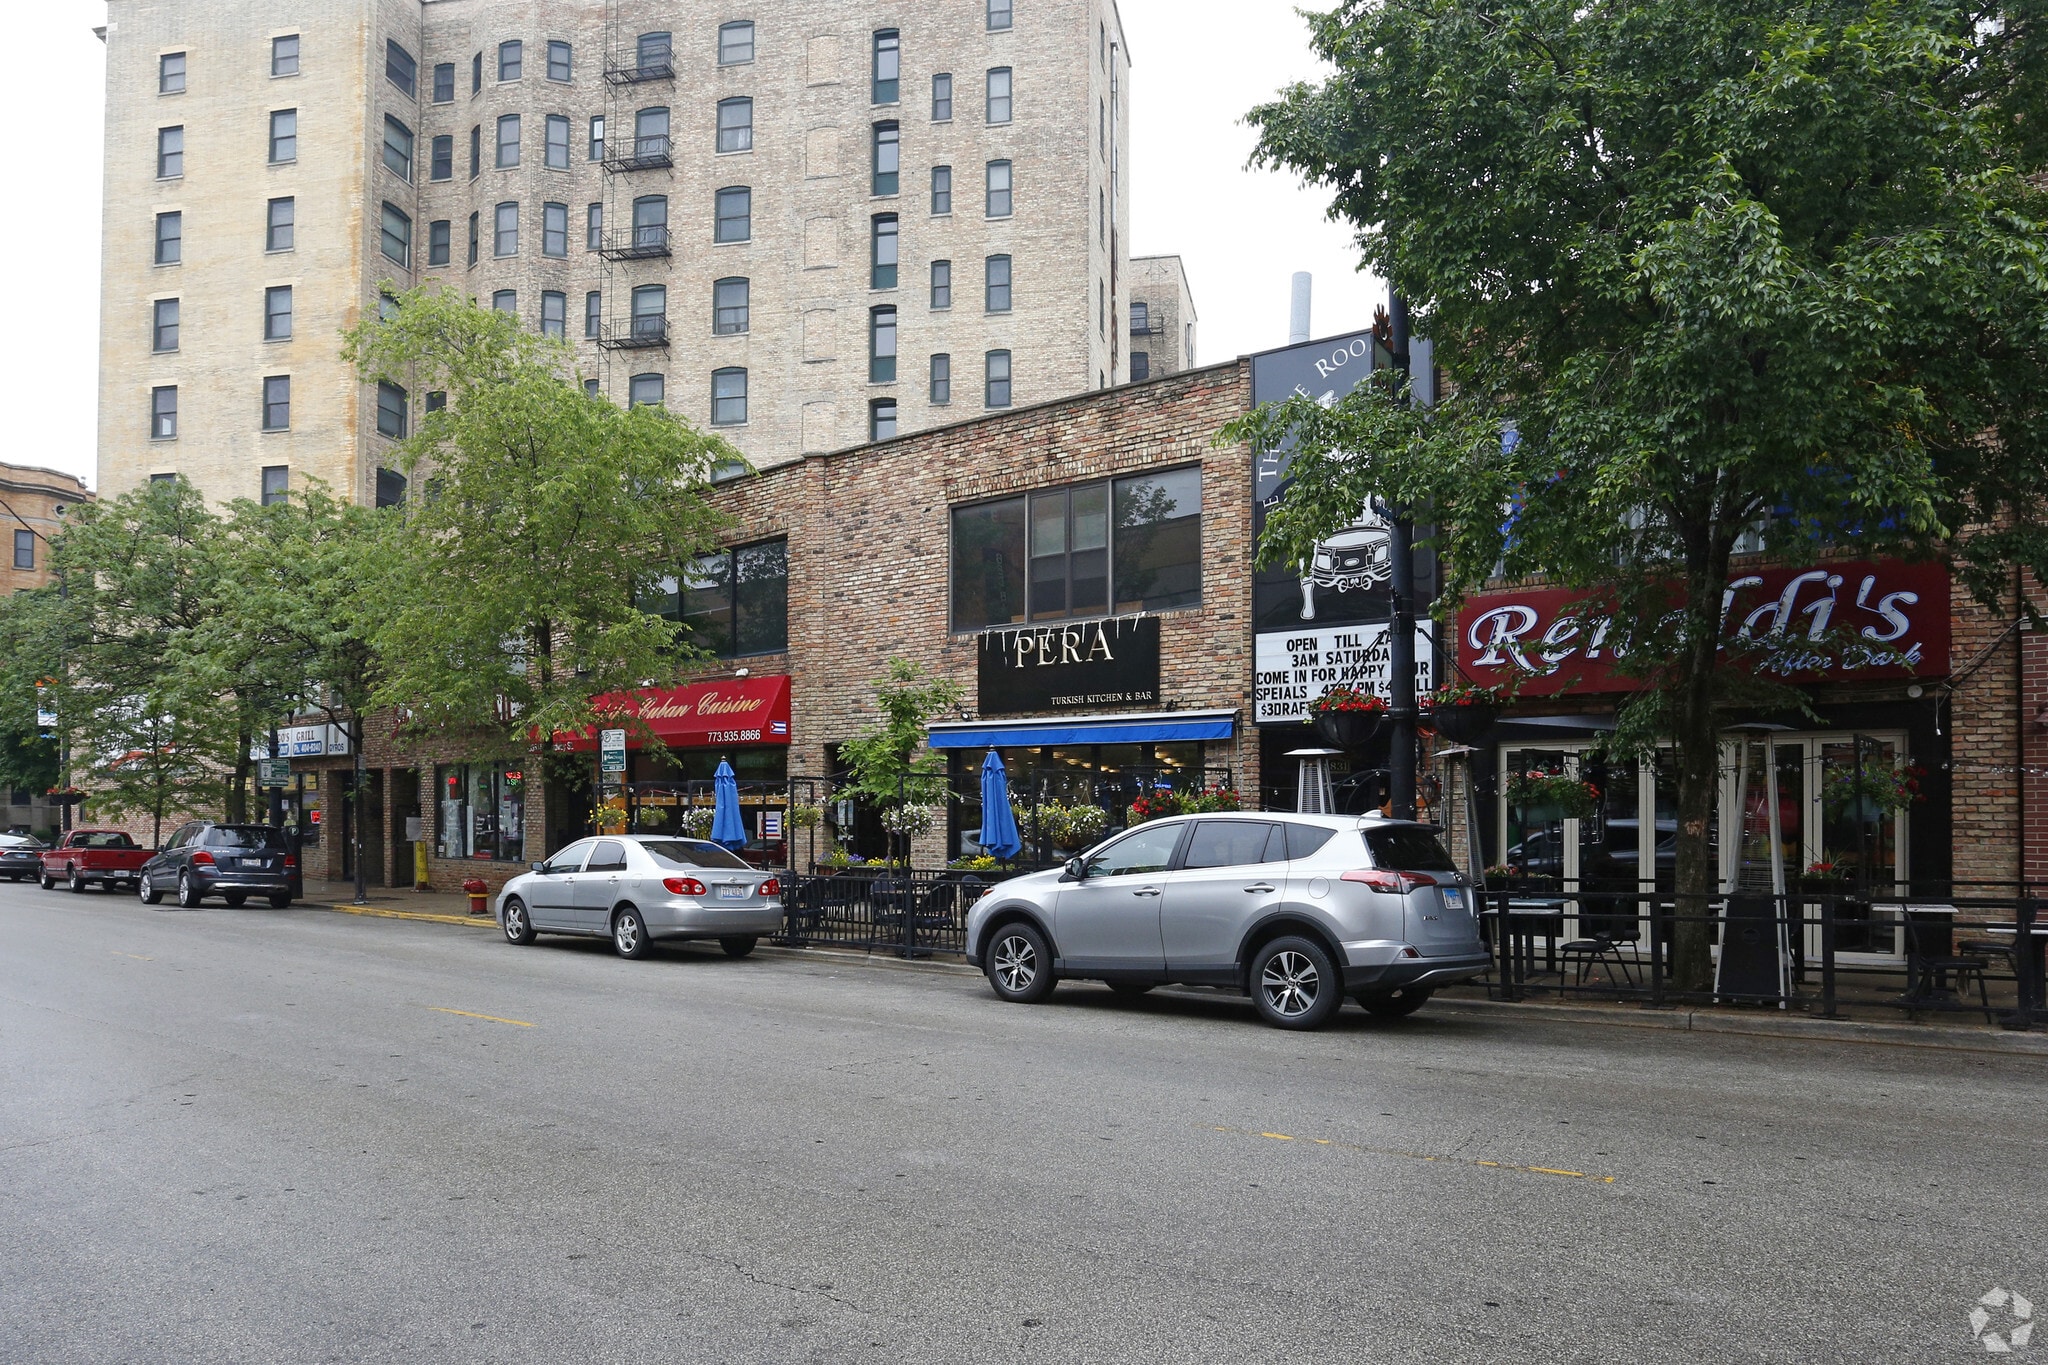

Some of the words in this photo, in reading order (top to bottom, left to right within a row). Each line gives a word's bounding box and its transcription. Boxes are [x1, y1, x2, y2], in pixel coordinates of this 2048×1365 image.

[1313, 338, 1372, 379] ROO
[1015, 628, 1114, 668] PERA
[1286, 637, 1317, 652] OPEN
[1333, 633, 1362, 648] TILL
[1377, 631, 1391, 645] 2A
[1291, 652, 1319, 668] 3AM
[1326, 648, 1390, 665] SATURDA
[1256, 670, 1290, 685] COME
[1294, 669, 1307, 683] IN
[1311, 668, 1337, 682] FOR
[1341, 664, 1385, 680] HAPPY
[1050, 694, 1085, 706] TURKISH
[1087, 692, 1123, 704] KITCHEN
[1125, 691, 1132, 701] &
[1134, 690, 1153, 701] BAR
[1256, 685, 1308, 700] SPEIALS
[1357, 681, 1375, 694] PM
[637, 697, 695, 720] Cuban
[697, 691, 766, 716] Cuisine
[296, 730, 315, 742] GRILL
[707, 729, 761, 742] 773.935.8866
[328, 743, 344, 752] GYROS
